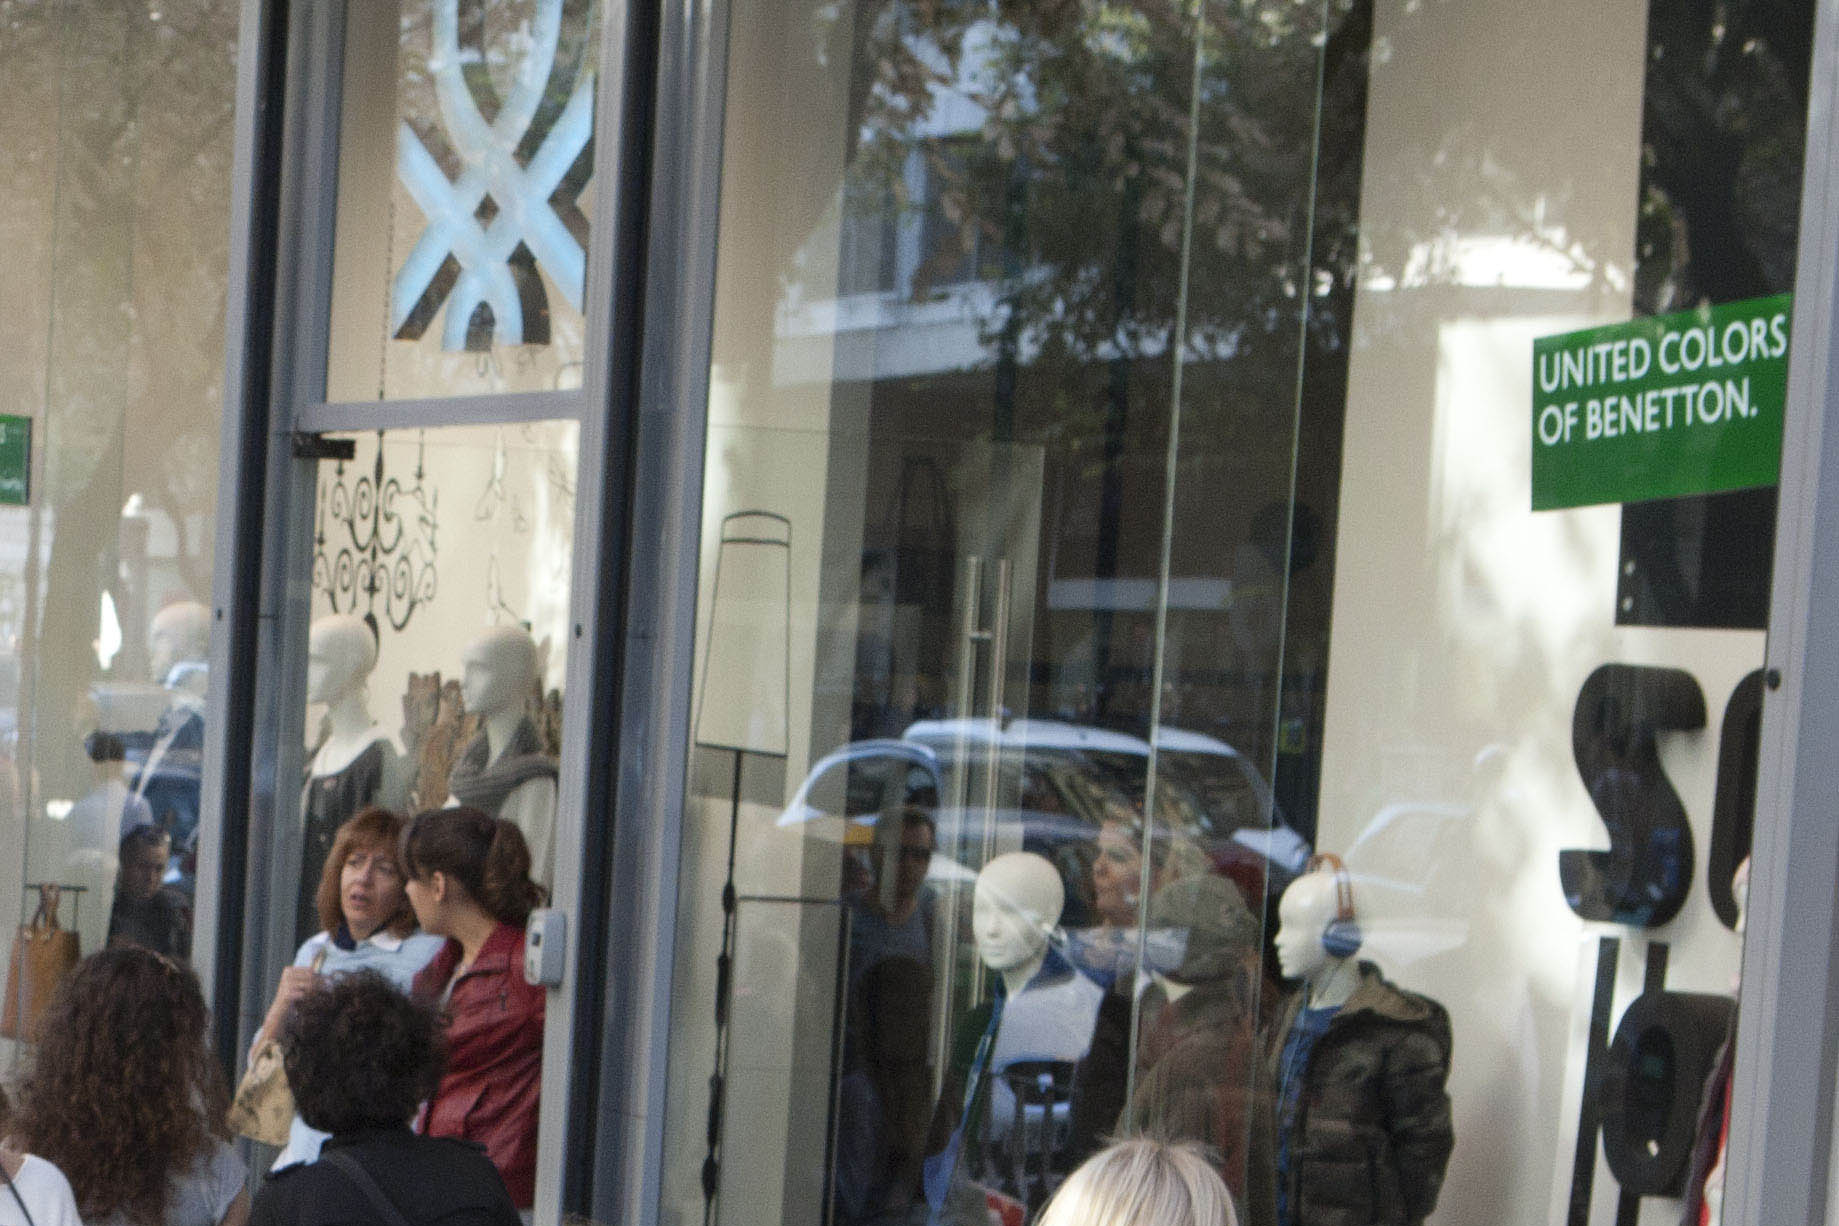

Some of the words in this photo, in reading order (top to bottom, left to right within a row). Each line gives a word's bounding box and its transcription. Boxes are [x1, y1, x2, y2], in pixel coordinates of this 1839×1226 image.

[1539, 338, 1652, 393] UNITED
[1658, 313, 1788, 375] COLORS
[1538, 402, 1579, 446] OF
[1585, 376, 1759, 441] BENETTON.
